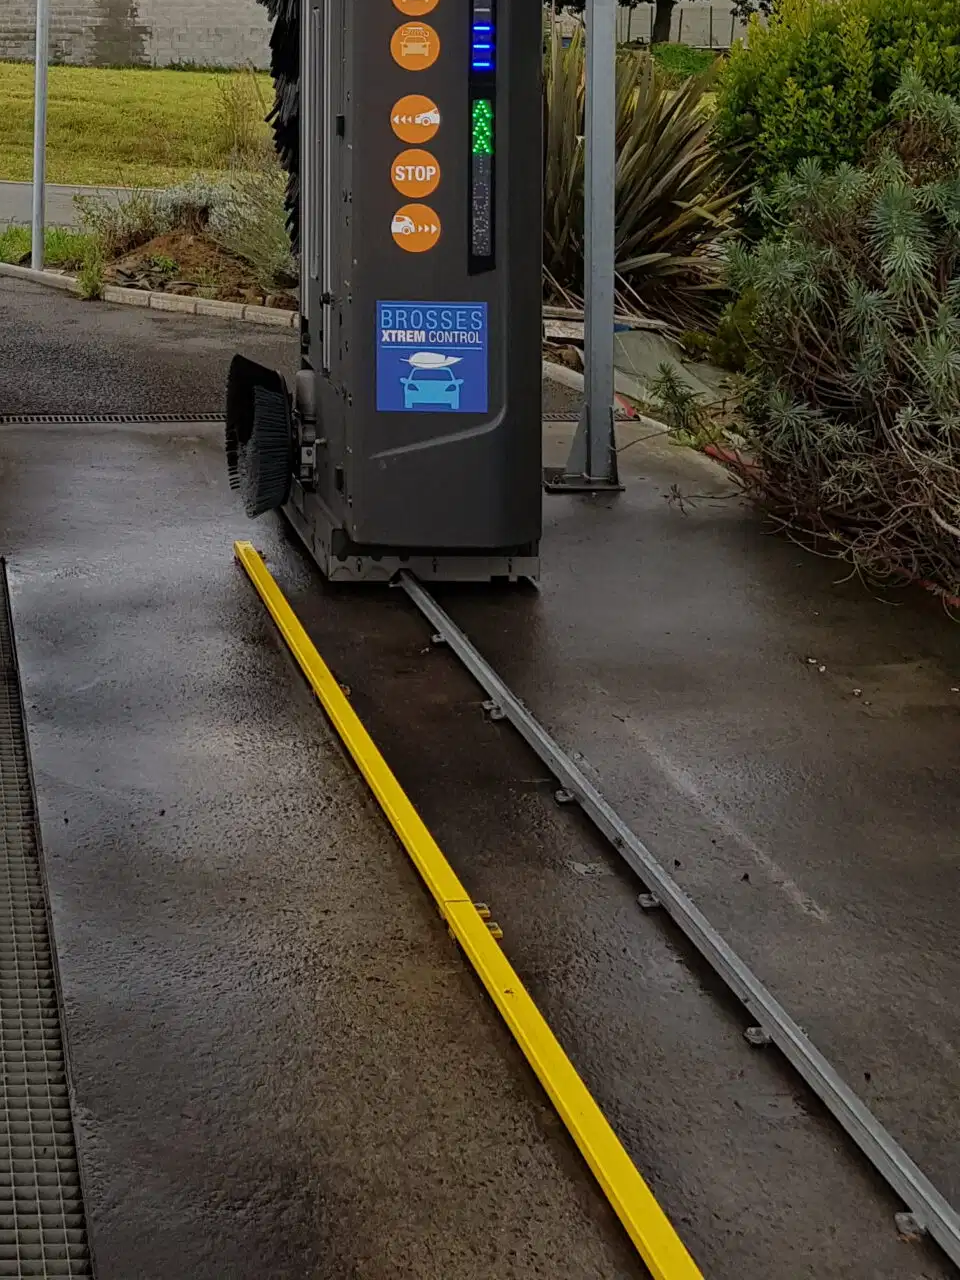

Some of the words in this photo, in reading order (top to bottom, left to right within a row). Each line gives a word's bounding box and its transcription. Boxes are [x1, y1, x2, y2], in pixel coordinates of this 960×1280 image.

[395, 165, 436, 181] STOP
[381, 309, 482, 330] BROSSES
[381, 329, 425, 342] XTREM
[428, 330, 482, 343] CONTROL
